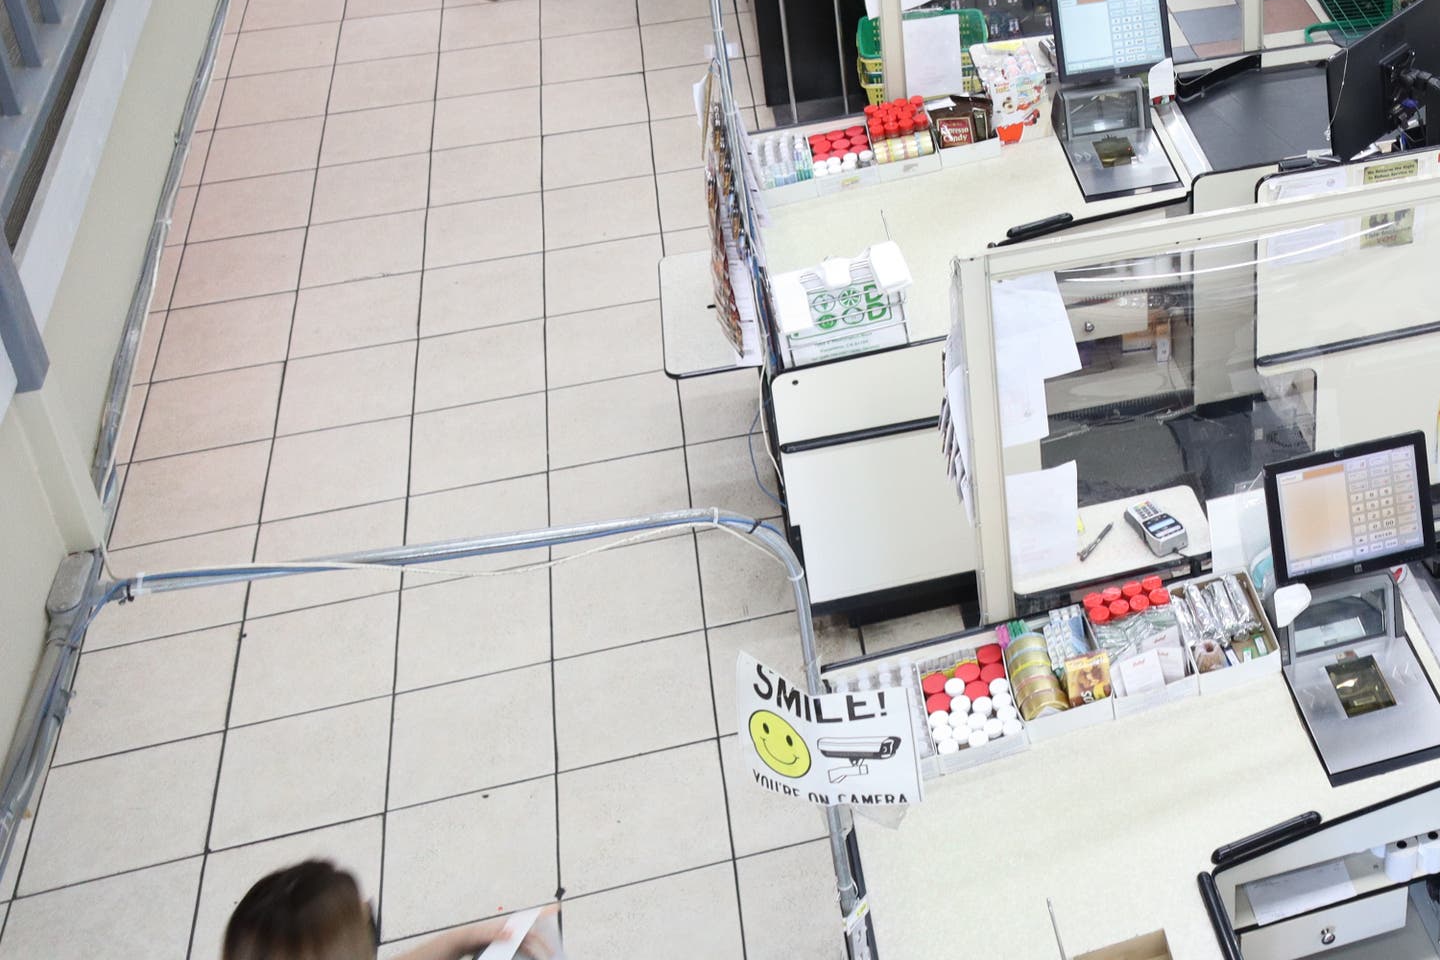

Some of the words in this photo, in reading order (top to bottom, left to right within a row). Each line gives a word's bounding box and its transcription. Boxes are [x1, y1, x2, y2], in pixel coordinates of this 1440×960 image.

[753, 663, 887, 724] SMILE!
[808, 793, 830, 804] ON
[838, 793, 908, 804] CAMERA
